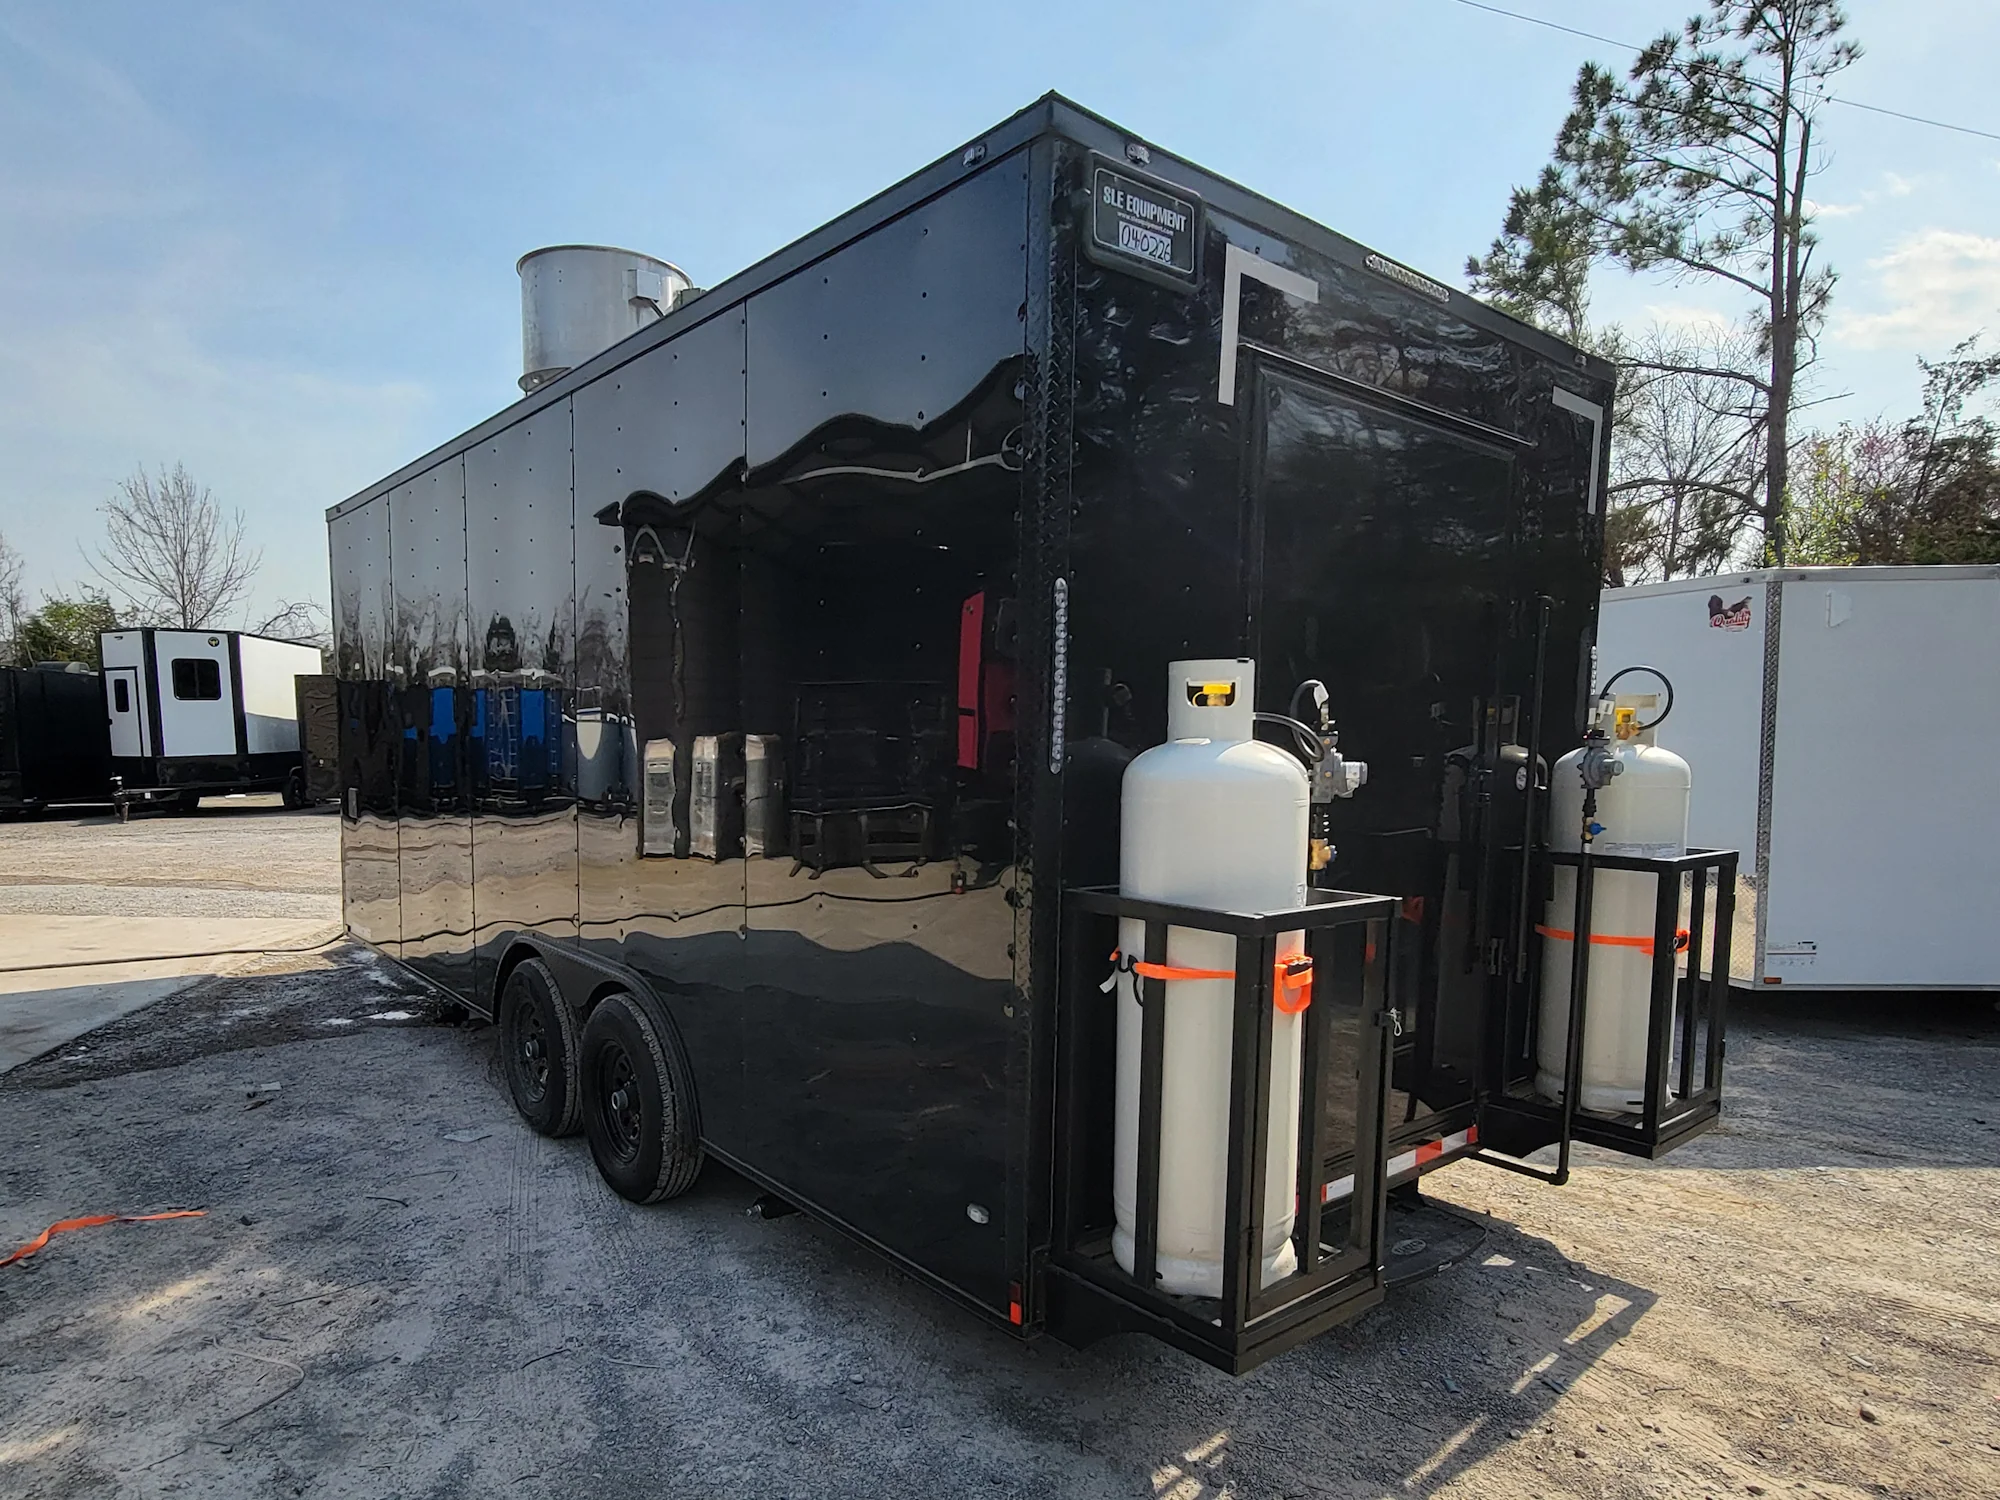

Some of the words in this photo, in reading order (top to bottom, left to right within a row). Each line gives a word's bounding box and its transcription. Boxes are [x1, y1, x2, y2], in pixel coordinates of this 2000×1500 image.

[1103, 186, 1124, 209] SLE
[1126, 194, 1187, 232] EQUIPMENT
[1712, 610, 1751, 629] Quality
